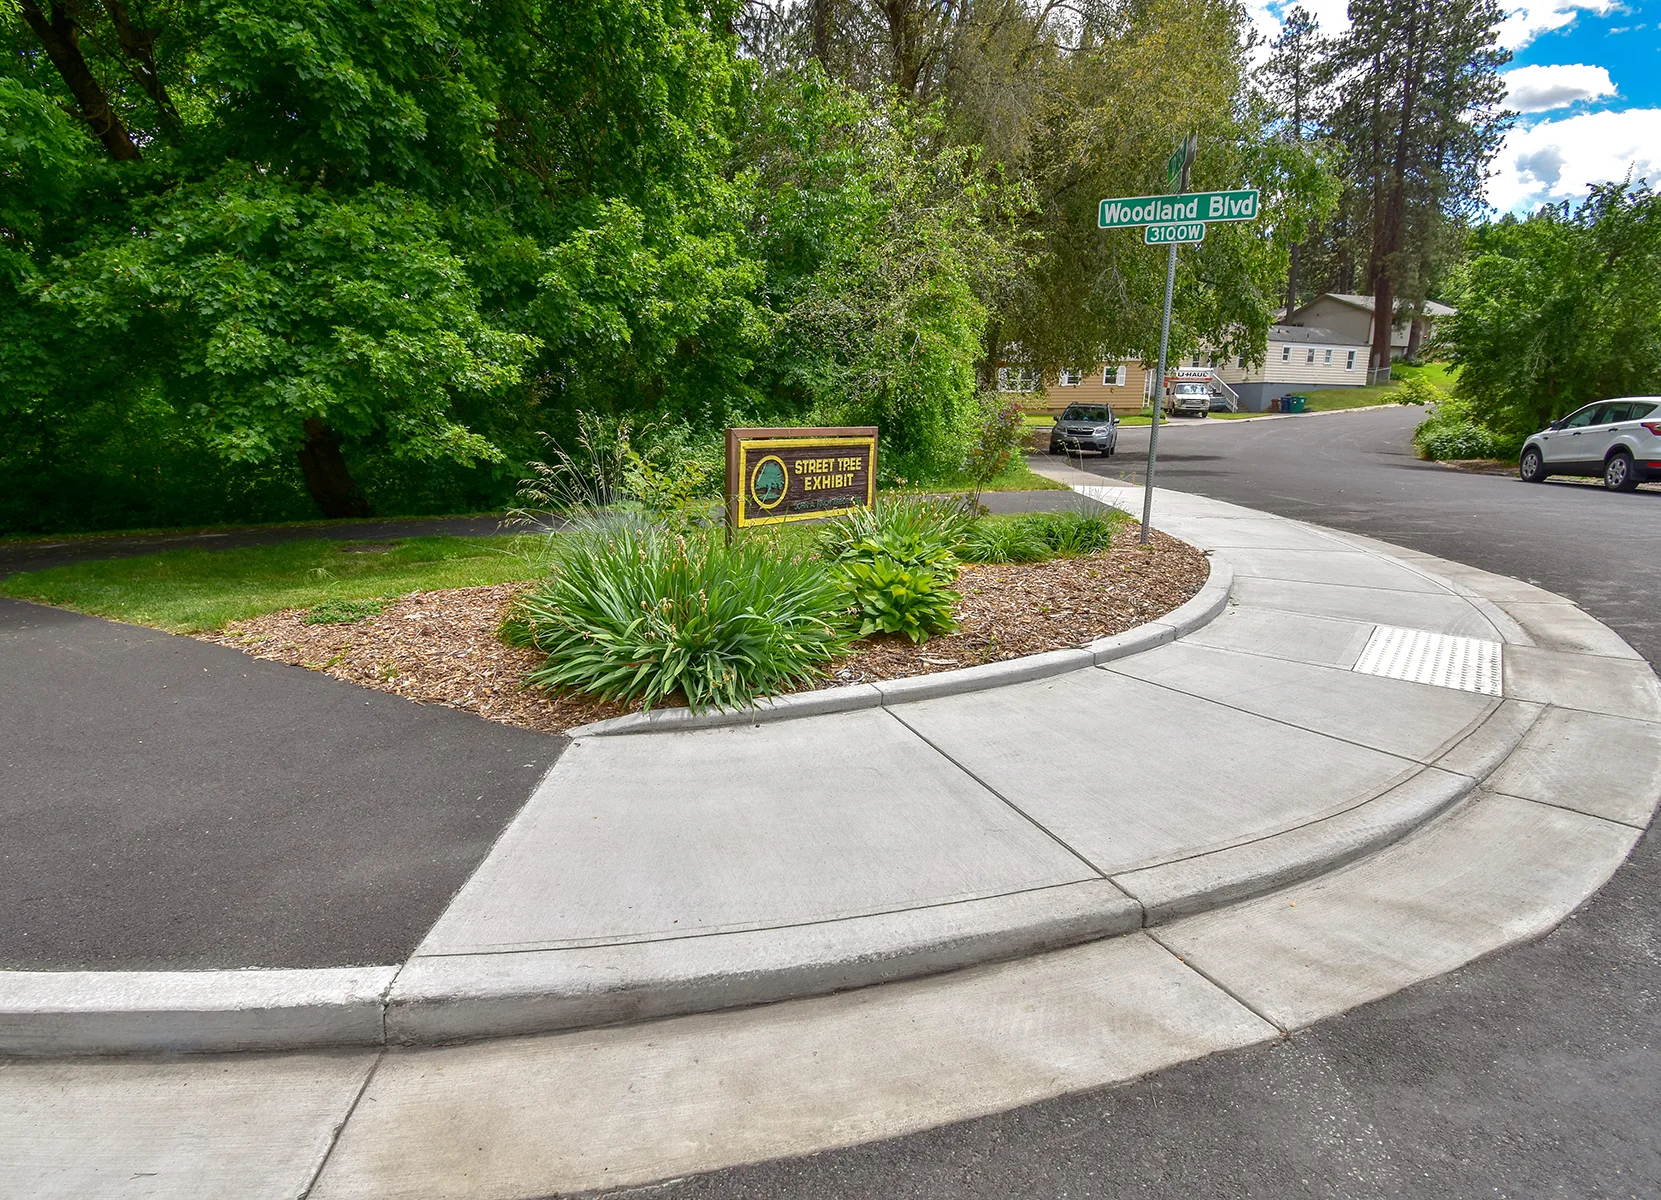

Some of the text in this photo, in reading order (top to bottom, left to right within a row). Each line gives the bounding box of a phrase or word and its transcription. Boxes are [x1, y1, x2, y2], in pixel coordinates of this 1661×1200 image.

[1104, 194, 1254, 224] Woodland Blvd
[1150, 224, 1201, 242] 3100W
[794, 457, 862, 474] STREET TREE
[804, 473, 854, 491] EXHIBIT
